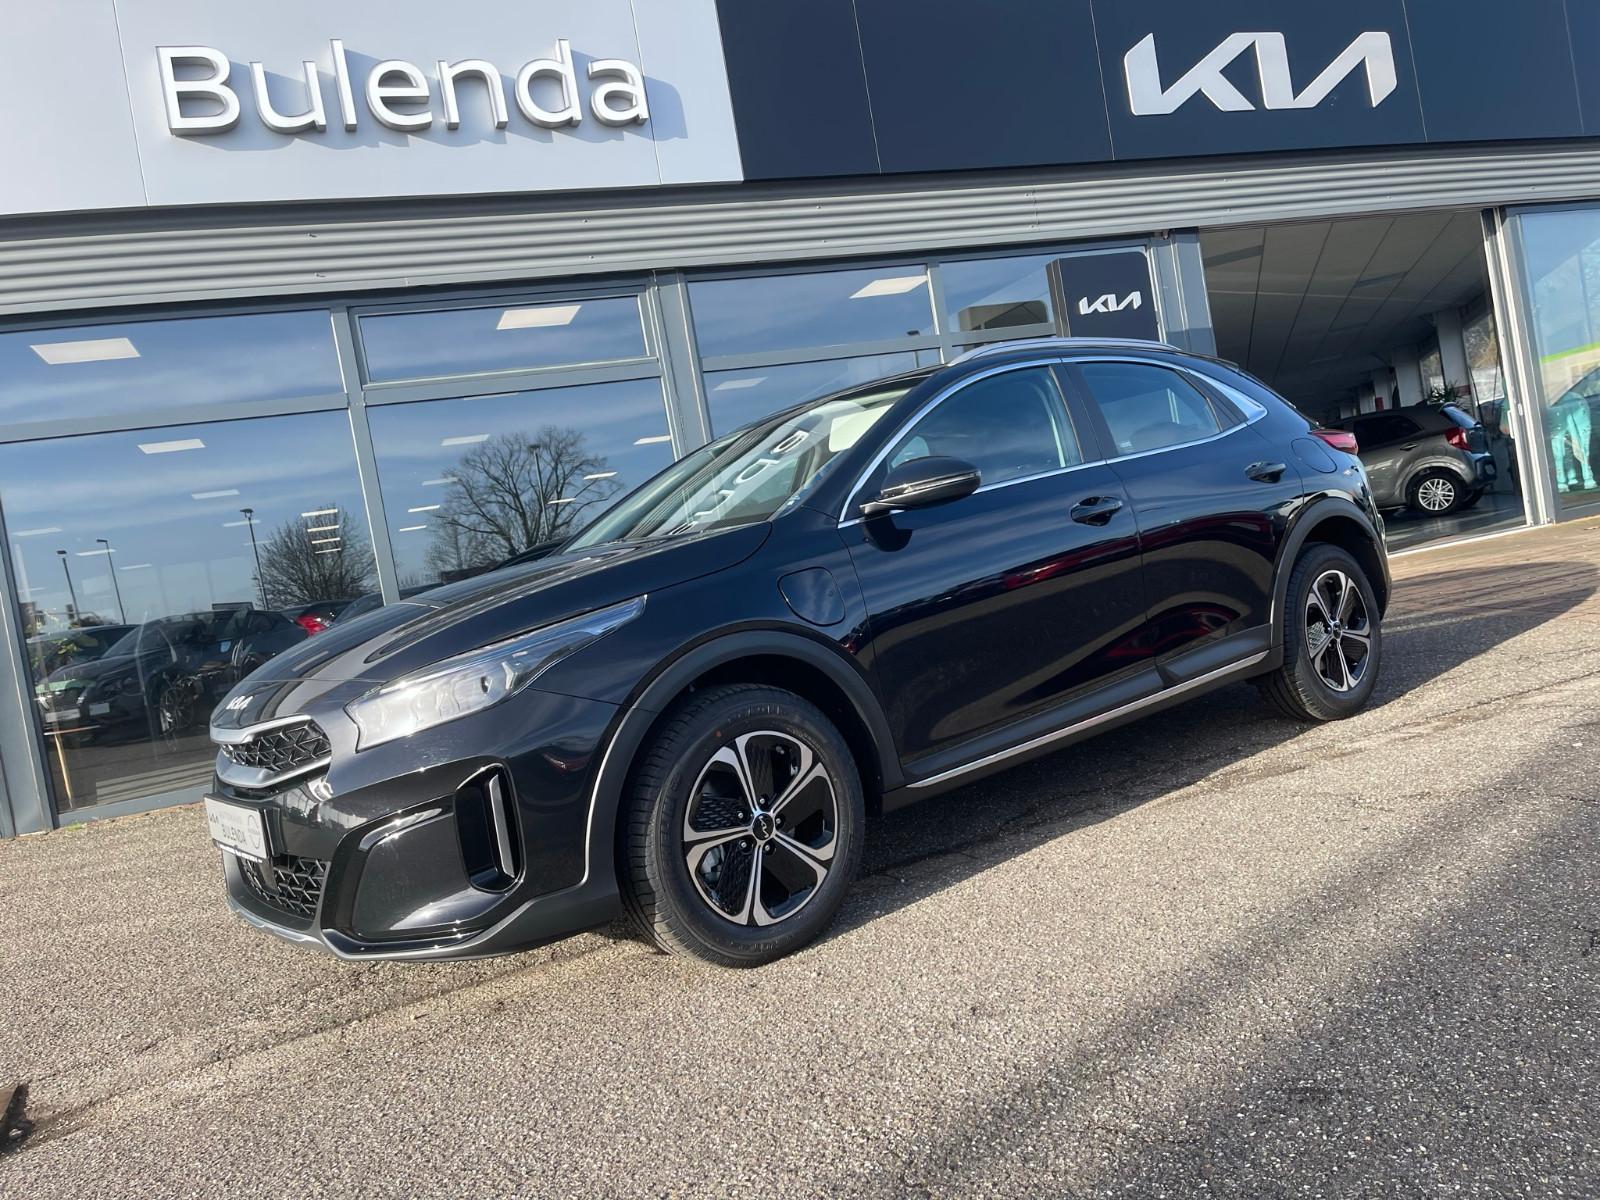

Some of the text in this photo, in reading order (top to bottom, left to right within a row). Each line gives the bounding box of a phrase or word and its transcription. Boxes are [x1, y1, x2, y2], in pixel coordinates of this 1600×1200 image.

[155, 38, 649, 137] Bulenda
[1124, 31, 1398, 116] KIA
[1079, 291, 1142, 315] KIA
